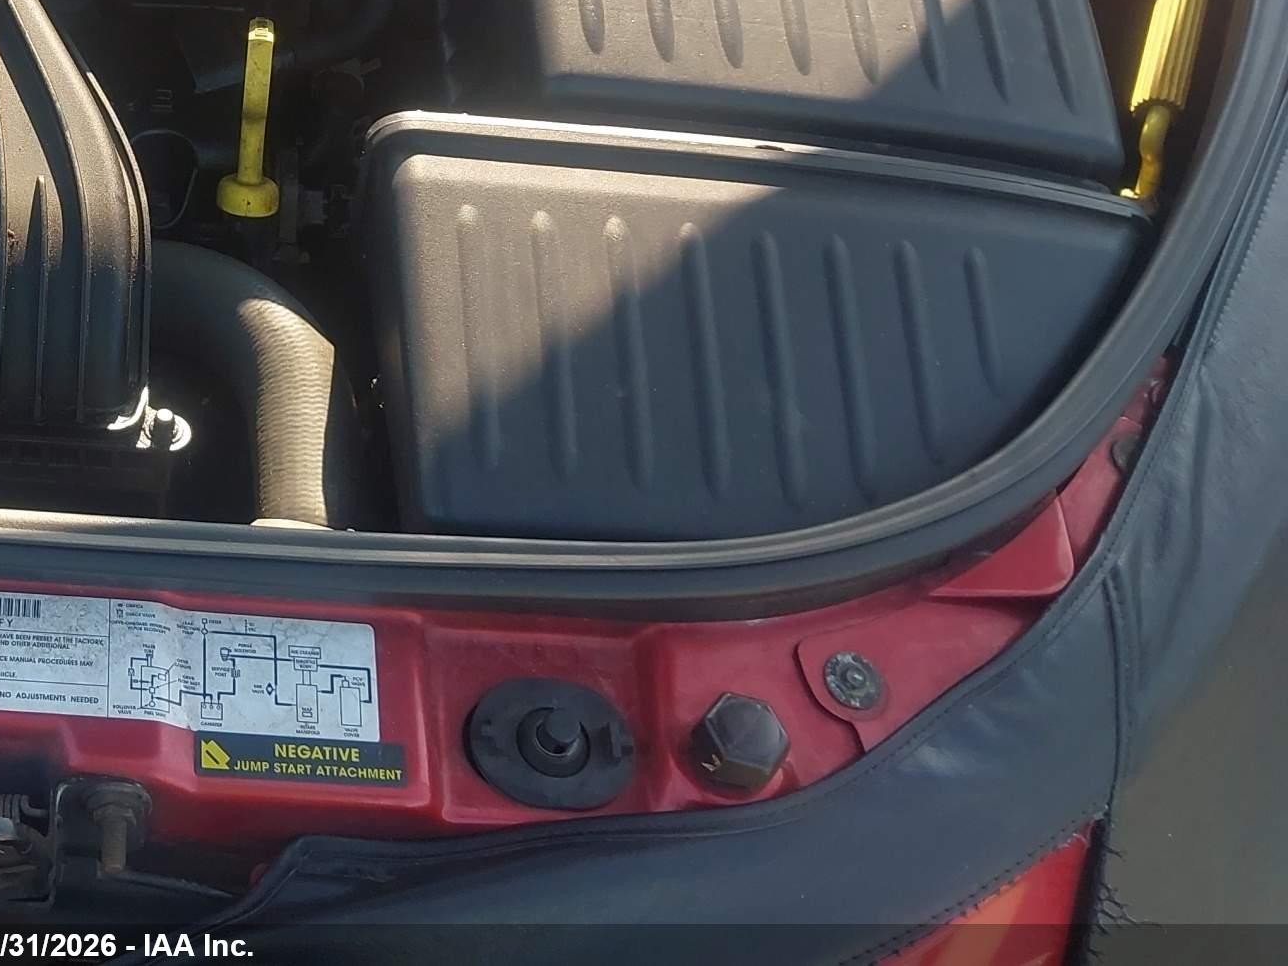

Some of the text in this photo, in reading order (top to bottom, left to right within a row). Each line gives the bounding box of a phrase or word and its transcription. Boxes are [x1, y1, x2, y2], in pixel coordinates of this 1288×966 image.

[32, 641, 70, 649] ADDITIONAL
[37, 658, 78, 666] PROCEDURES
[15, 692, 66, 702] ADJUSTMENTS
[70, 696, 99, 704] NEEDED
[274, 743, 360, 762] NEGATIVE
[233, 760, 403, 781] JUMP START ATTACHMENT
